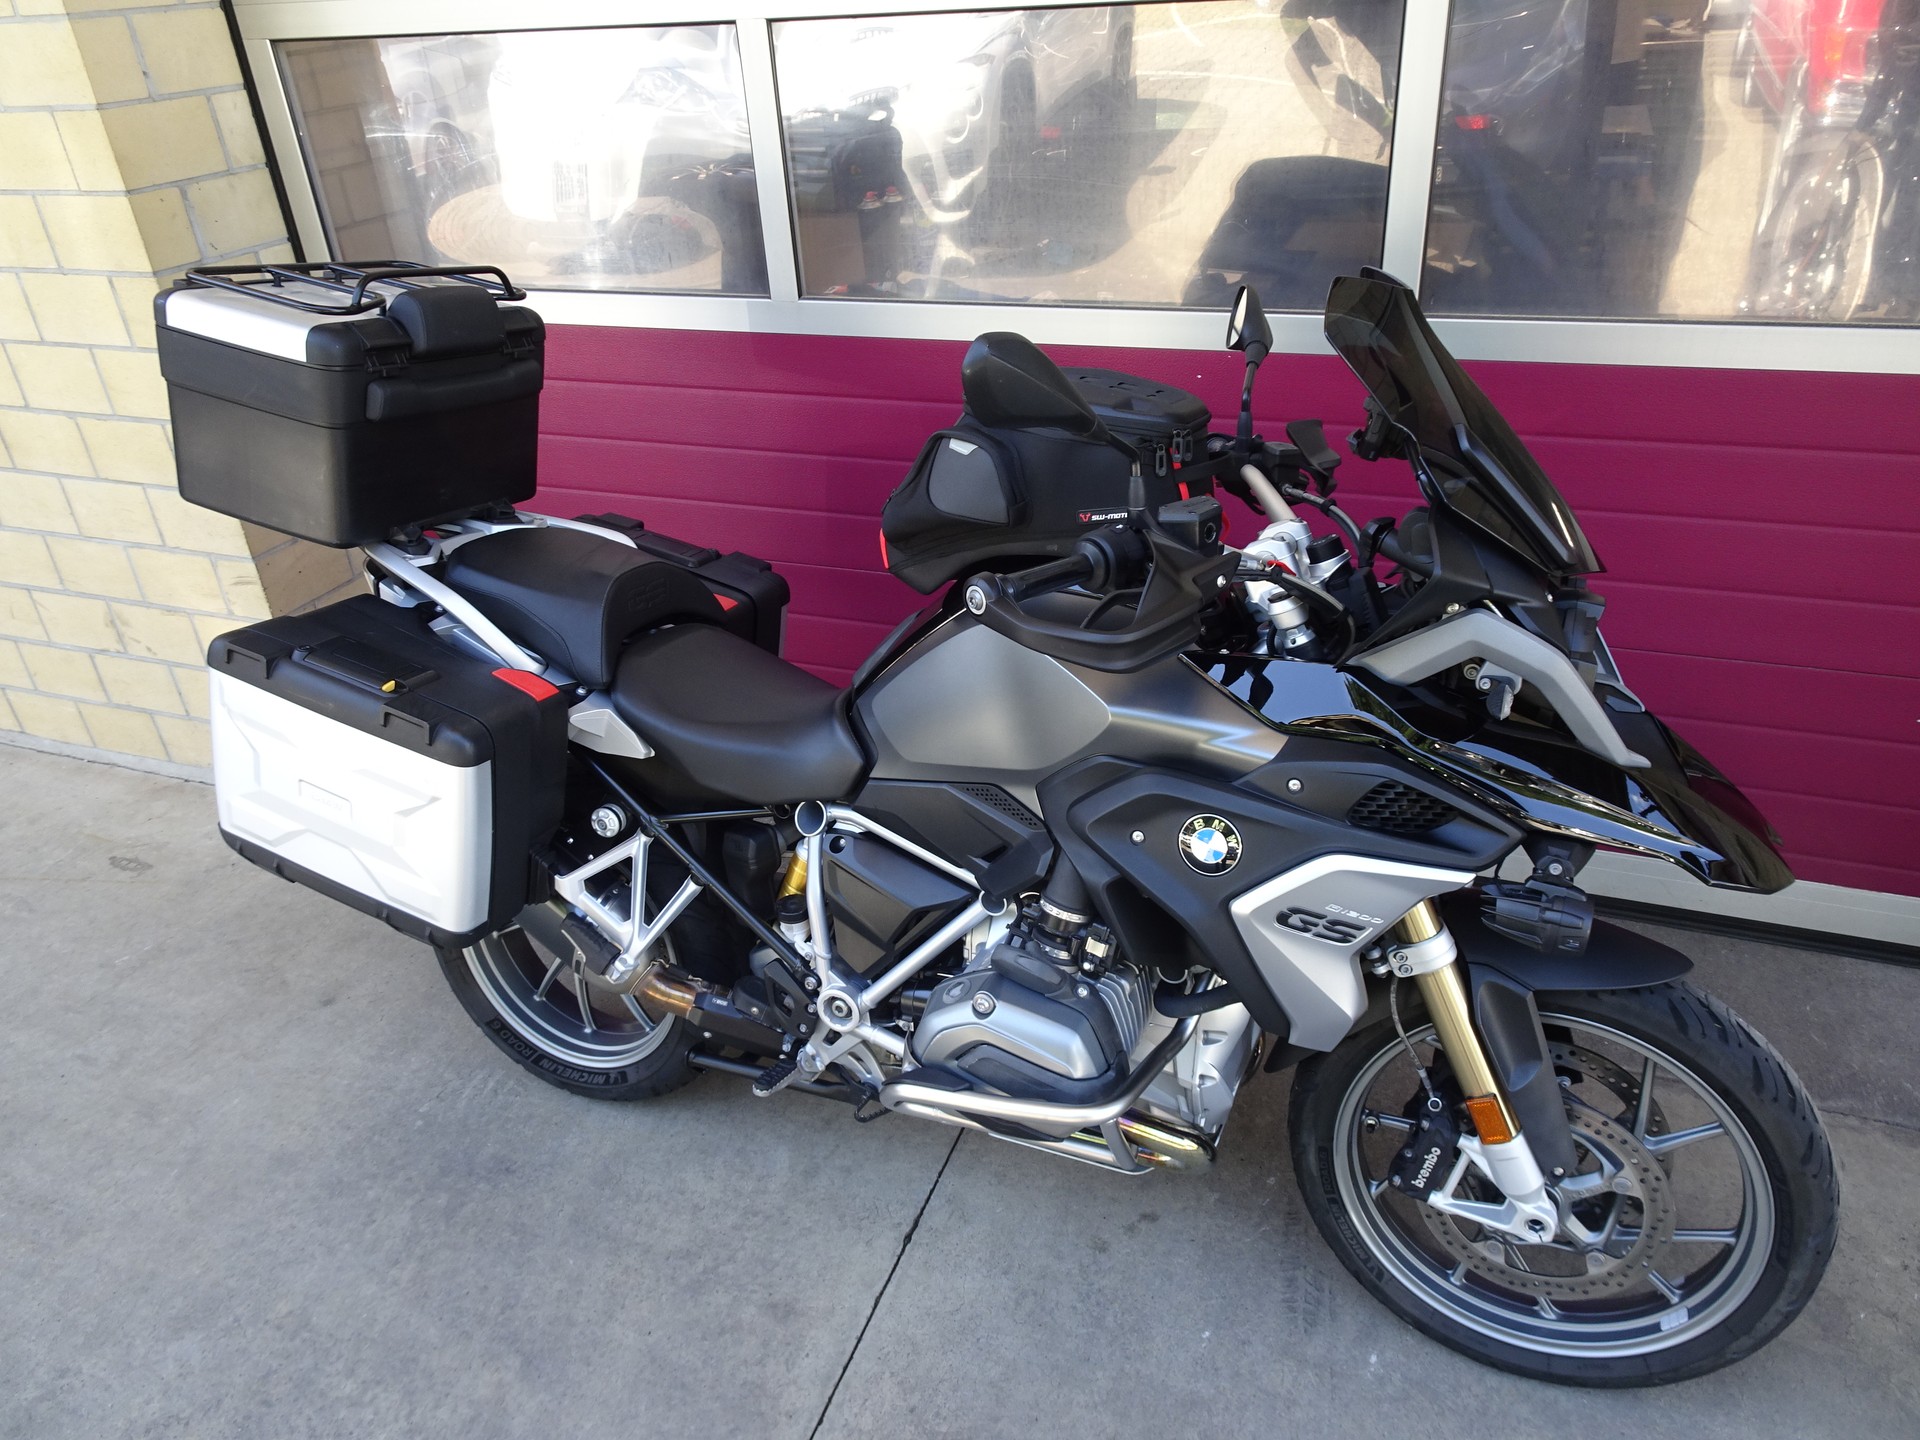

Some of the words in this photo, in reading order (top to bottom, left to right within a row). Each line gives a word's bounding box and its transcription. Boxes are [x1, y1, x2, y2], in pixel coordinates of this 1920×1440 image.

[1193, 818, 1239, 850] BMW
[1274, 906, 1367, 944] GS
[499, 1029, 534, 1059] ROAD
[538, 1057, 606, 1086] MICHELIN
[1411, 1146, 1441, 1189] brembo
[1329, 1204, 1369, 1259] MICHELIN
